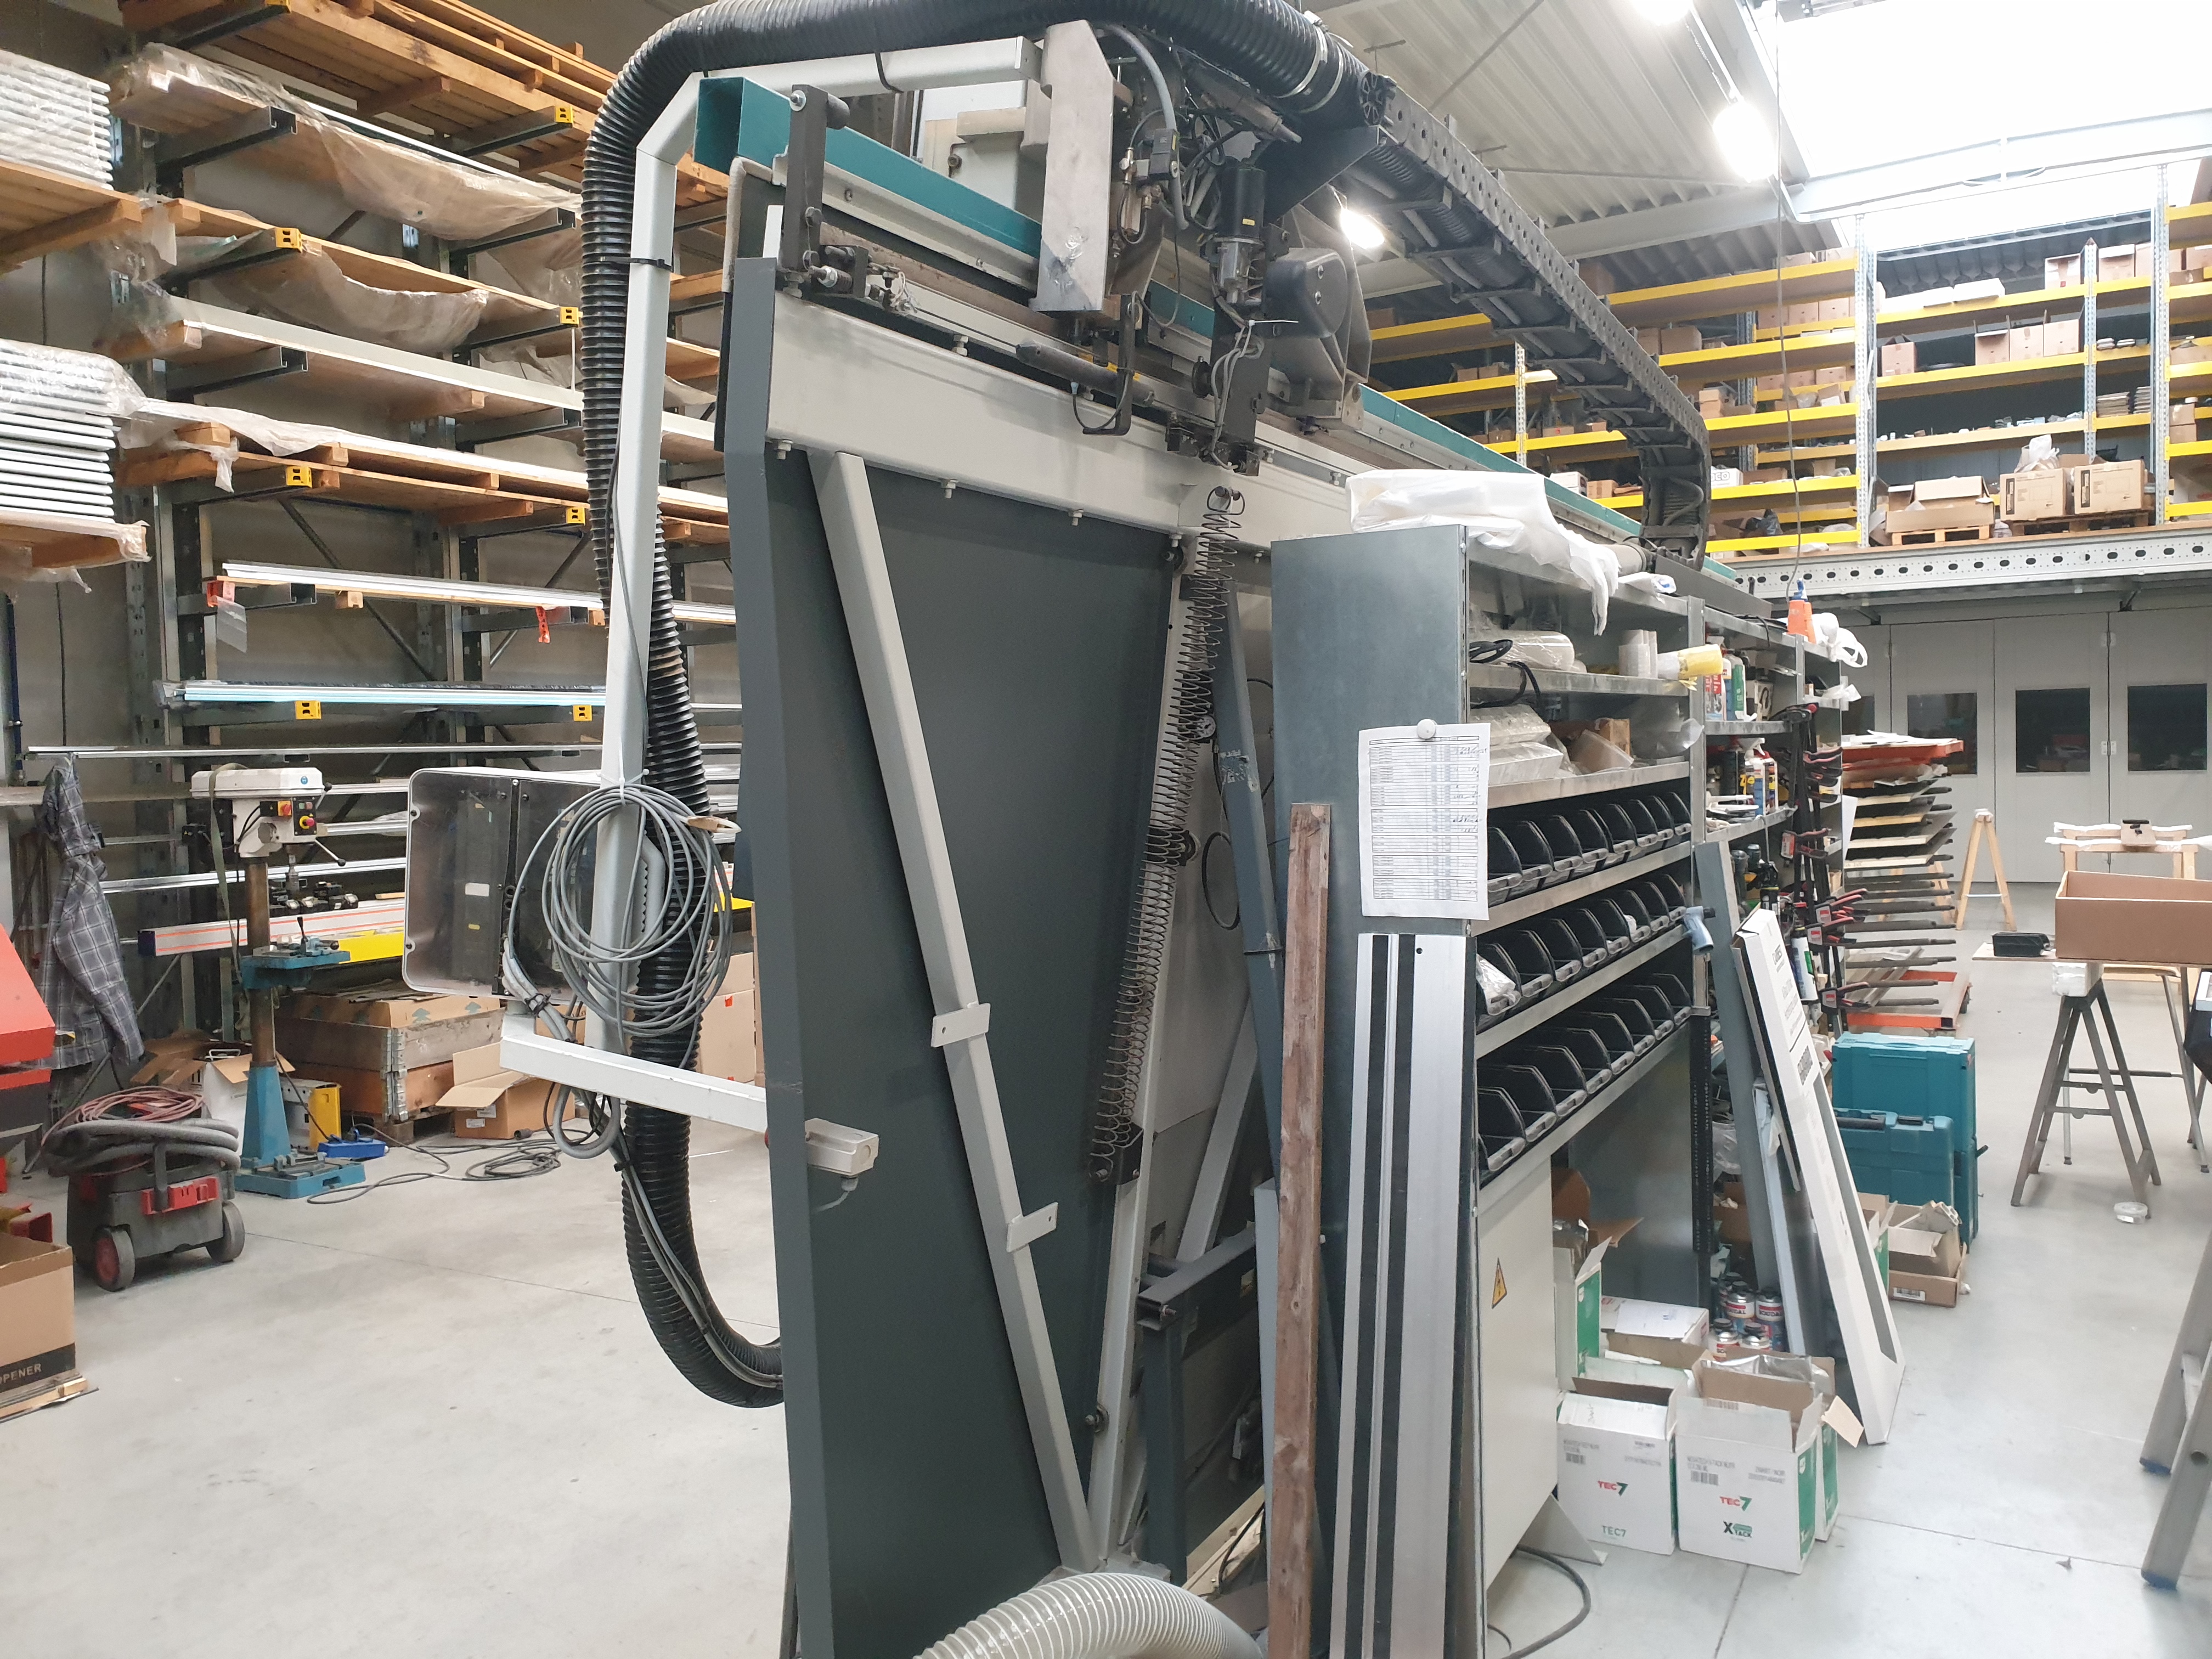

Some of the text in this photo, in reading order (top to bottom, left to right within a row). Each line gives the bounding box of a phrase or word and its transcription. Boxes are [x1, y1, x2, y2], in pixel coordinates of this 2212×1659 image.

[1597, 1480, 1628, 1497] TEC7
[1719, 1496, 1752, 1511] TEC7
[1602, 1525, 1627, 1537] TEC7
